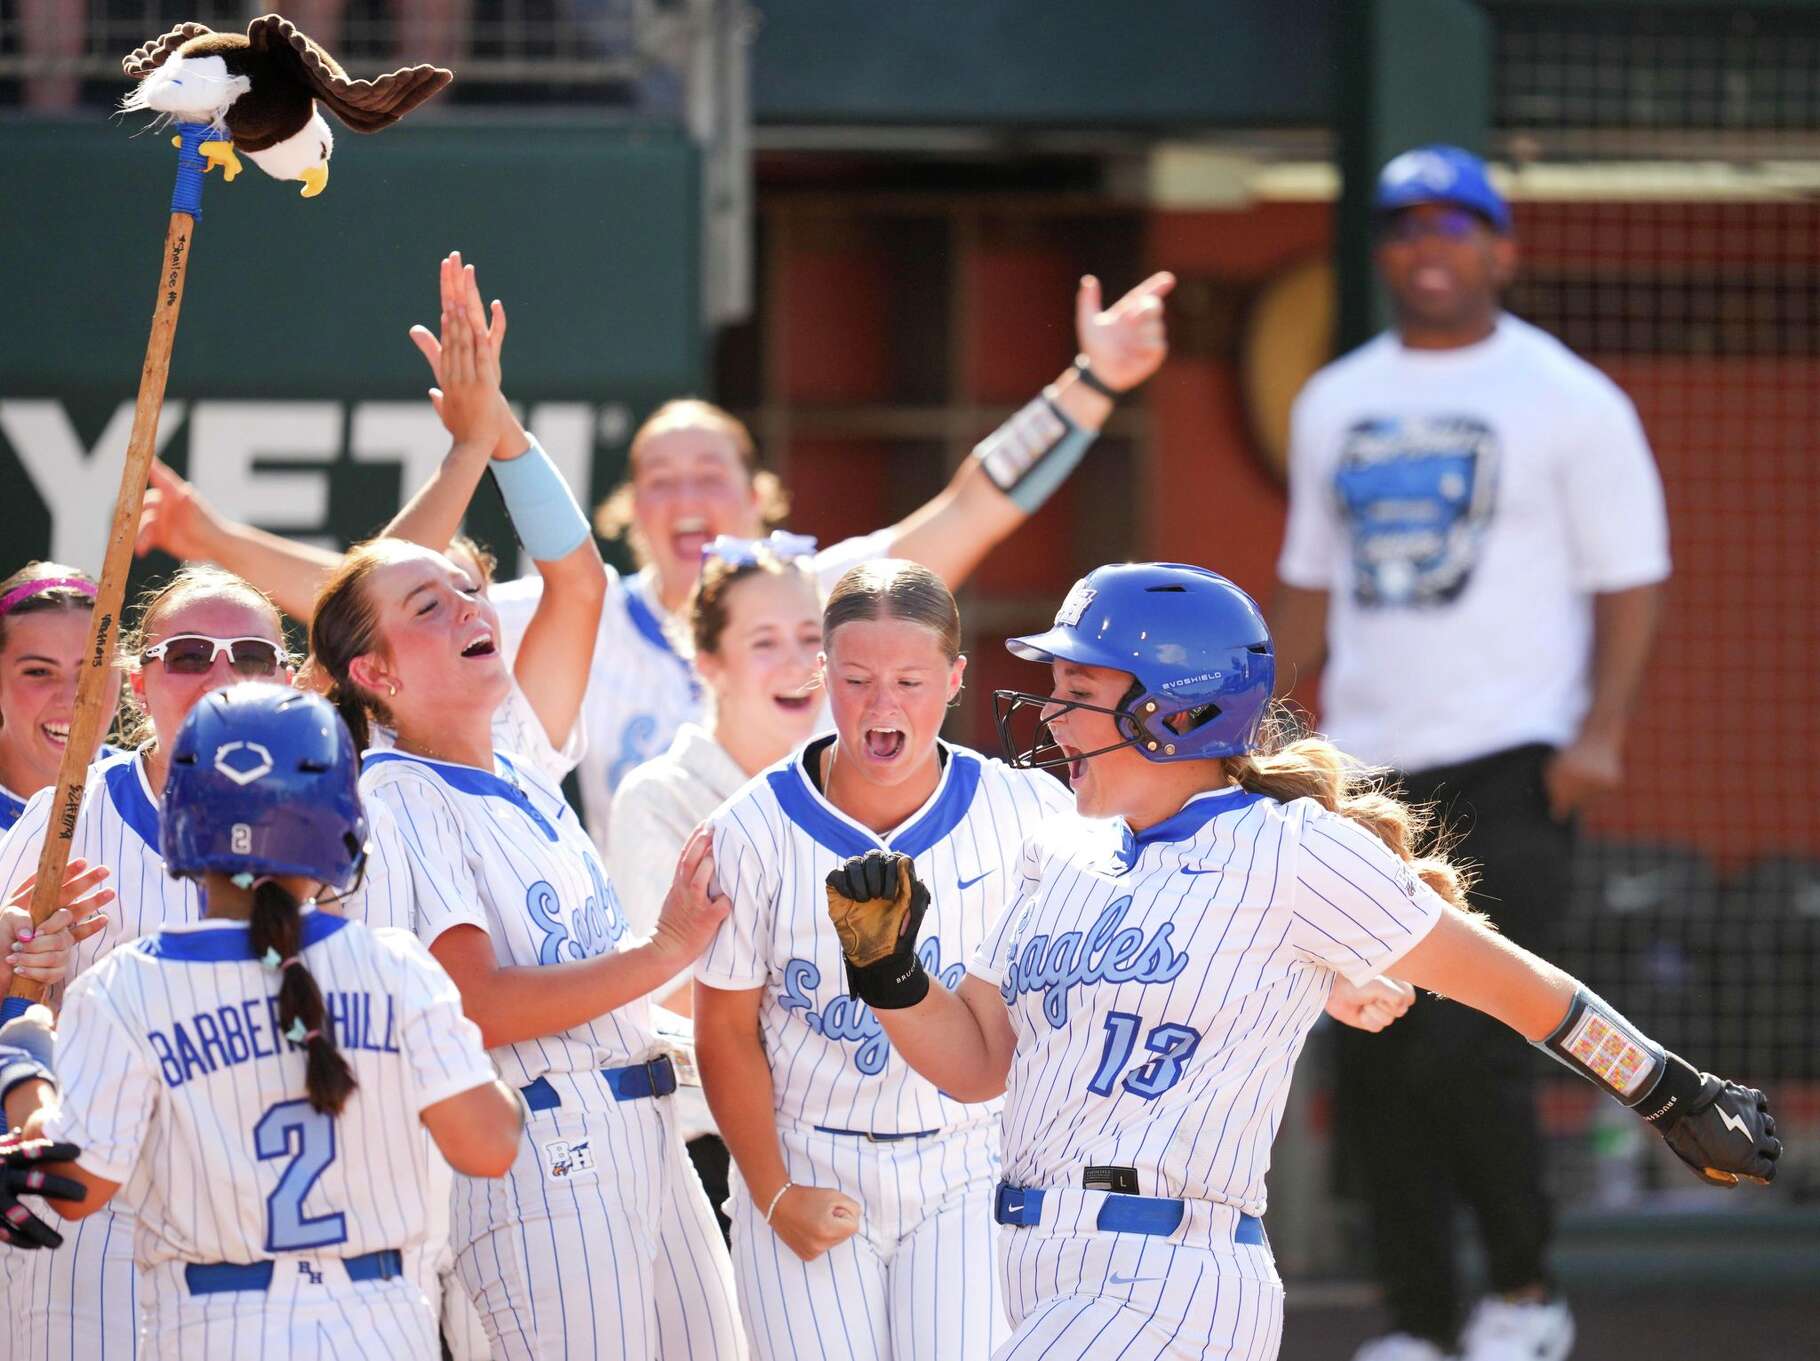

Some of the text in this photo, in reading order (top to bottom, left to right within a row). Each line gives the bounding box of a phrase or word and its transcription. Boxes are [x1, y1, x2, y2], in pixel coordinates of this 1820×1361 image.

[0, 397, 594, 578] YETI
[1161, 671, 1222, 690] EVOSHIELD
[231, 822, 252, 855] 2
[327, 992, 401, 1054] HILL
[1087, 1010, 1203, 1101] 13
[253, 1096, 348, 1252] 2
[1119, 1175, 1128, 1188] L
